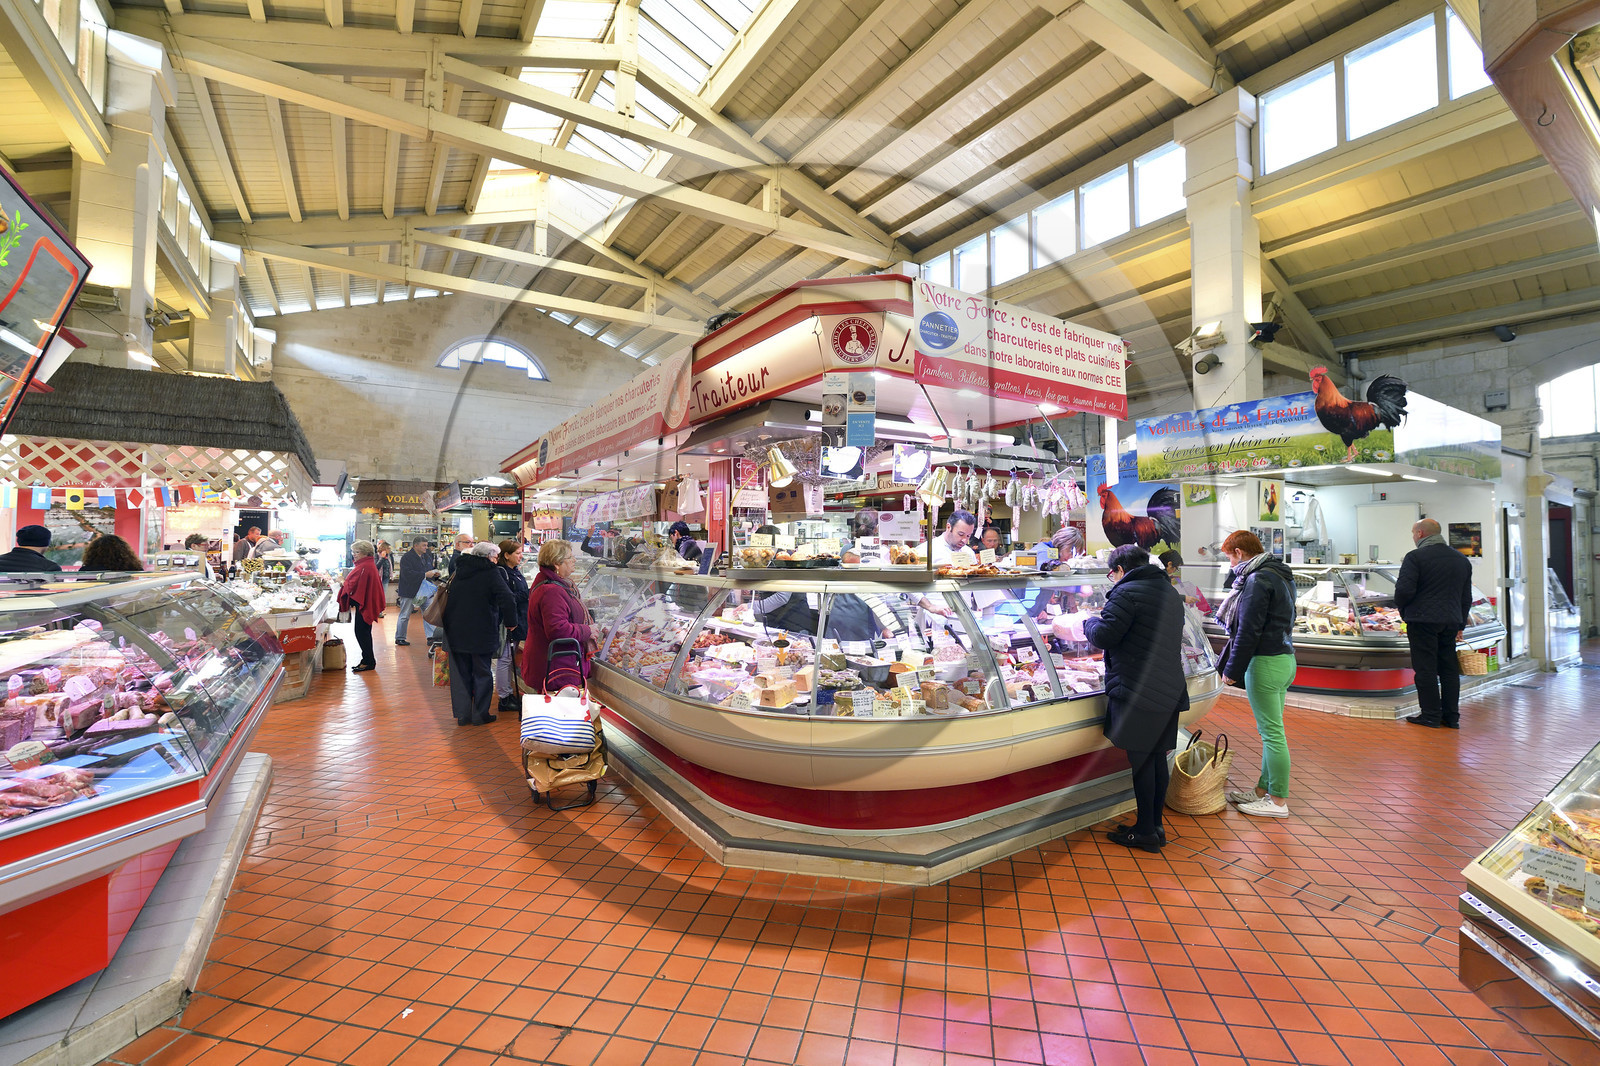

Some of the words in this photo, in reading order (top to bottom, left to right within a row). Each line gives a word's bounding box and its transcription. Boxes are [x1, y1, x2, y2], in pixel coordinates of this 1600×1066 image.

[920, 282, 961, 310] Notre
[966, 297, 1007, 324] Force
[1020, 316, 1046, 334] C'est
[1049, 324, 1061, 338] de
[1064, 328, 1104, 349] fabriquer
[1107, 343, 1122, 353] nos
[922, 320, 958, 334] PANNETIER
[987, 328, 1052, 354] charcuteries
[1054, 346, 1063, 356] et
[1065, 348, 1086, 362] plats
[1088, 354, 1120, 370] cuisinés
[964, 342, 987, 358] dans
[990, 350, 1012, 364] notre
[1016, 354, 1060, 374] laboratoire
[1062, 367, 1076, 378] aux
[1078, 370, 1103, 384] normes
[1106, 375, 1121, 388] CEE
[615, 395, 623, 408] nos
[625, 374, 660, 402] charcuteries
[1045, 387, 1056, 402] foie
[618, 412, 627, 426] aux
[1210, 443, 1223, 452] en
[1226, 434, 1262, 457] plein
[1268, 433, 1290, 444] air
[1184, 464, 1197, 473] 05
[1202, 462, 1215, 471] 46
[1219, 460, 1230, 469] 41
[1234, 459, 1248, 468] 65
[1252, 457, 1267, 466] 66
[462, 486, 489, 496] stef
